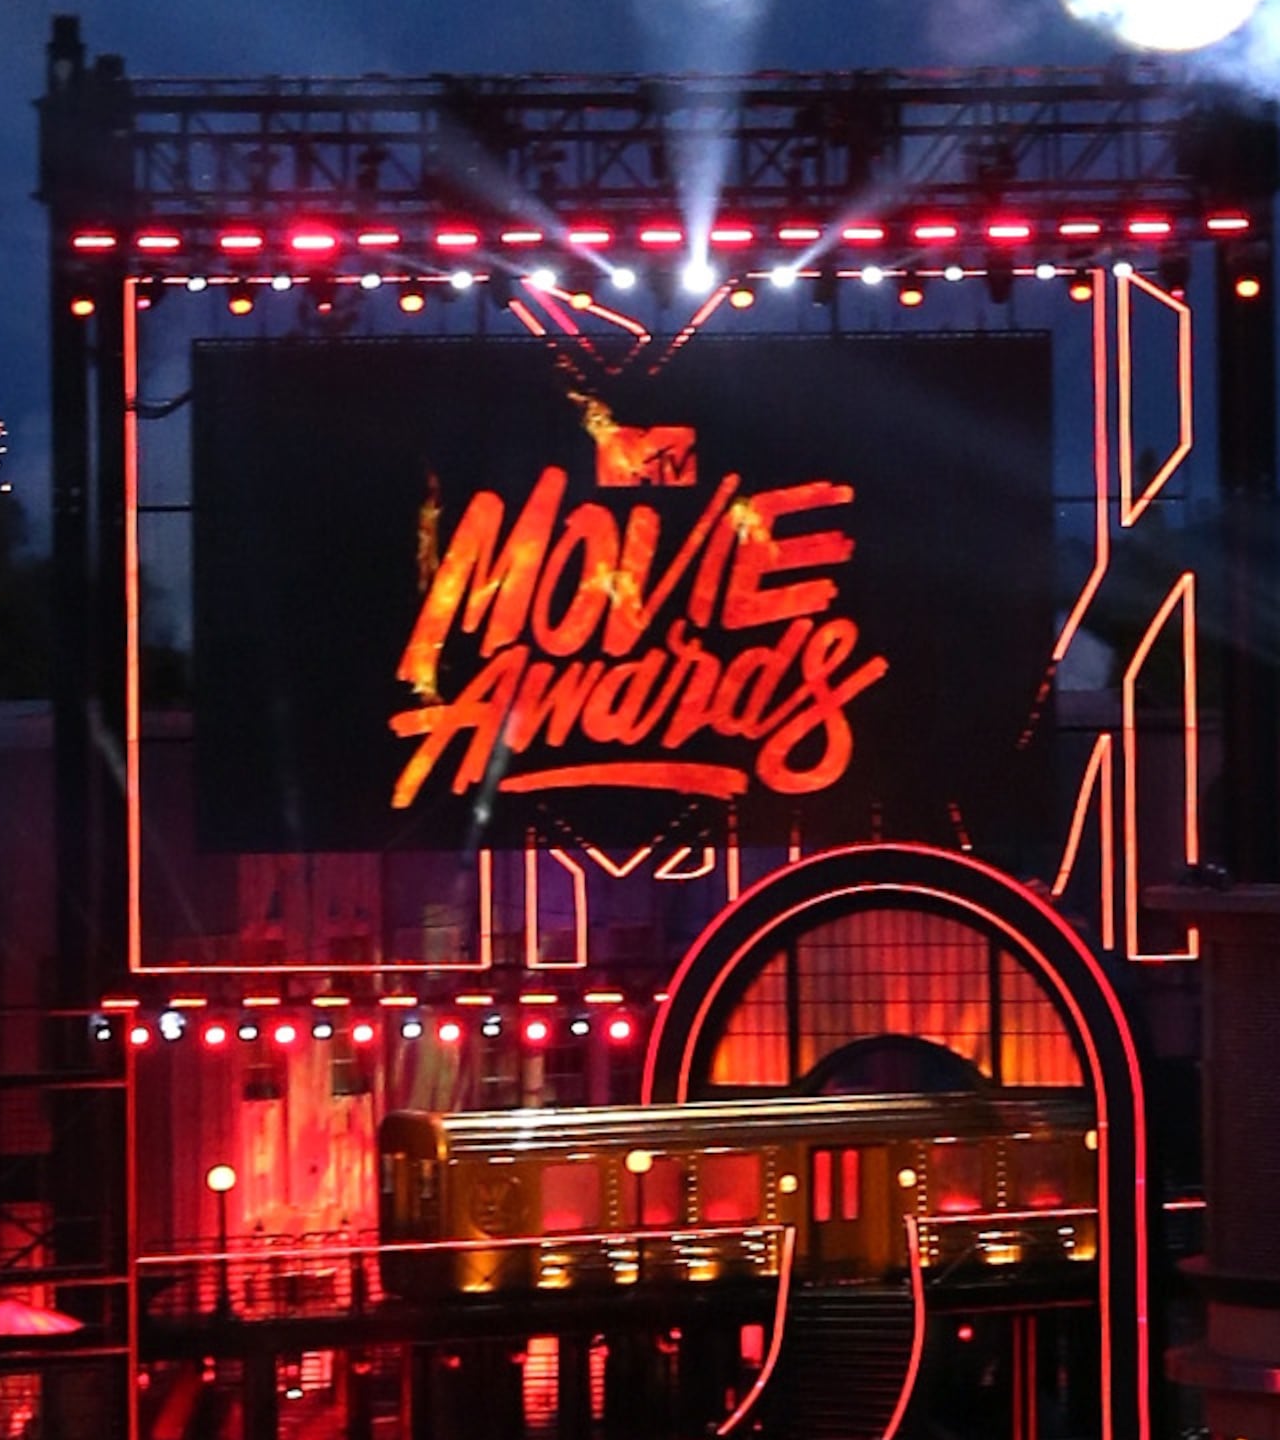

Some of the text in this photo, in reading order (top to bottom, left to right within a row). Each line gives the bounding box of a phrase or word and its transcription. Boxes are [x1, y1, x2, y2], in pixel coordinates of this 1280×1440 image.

[596, 425, 697, 487] MTV
[396, 466, 854, 682] MOVIE
[388, 618, 889, 809] Awards
